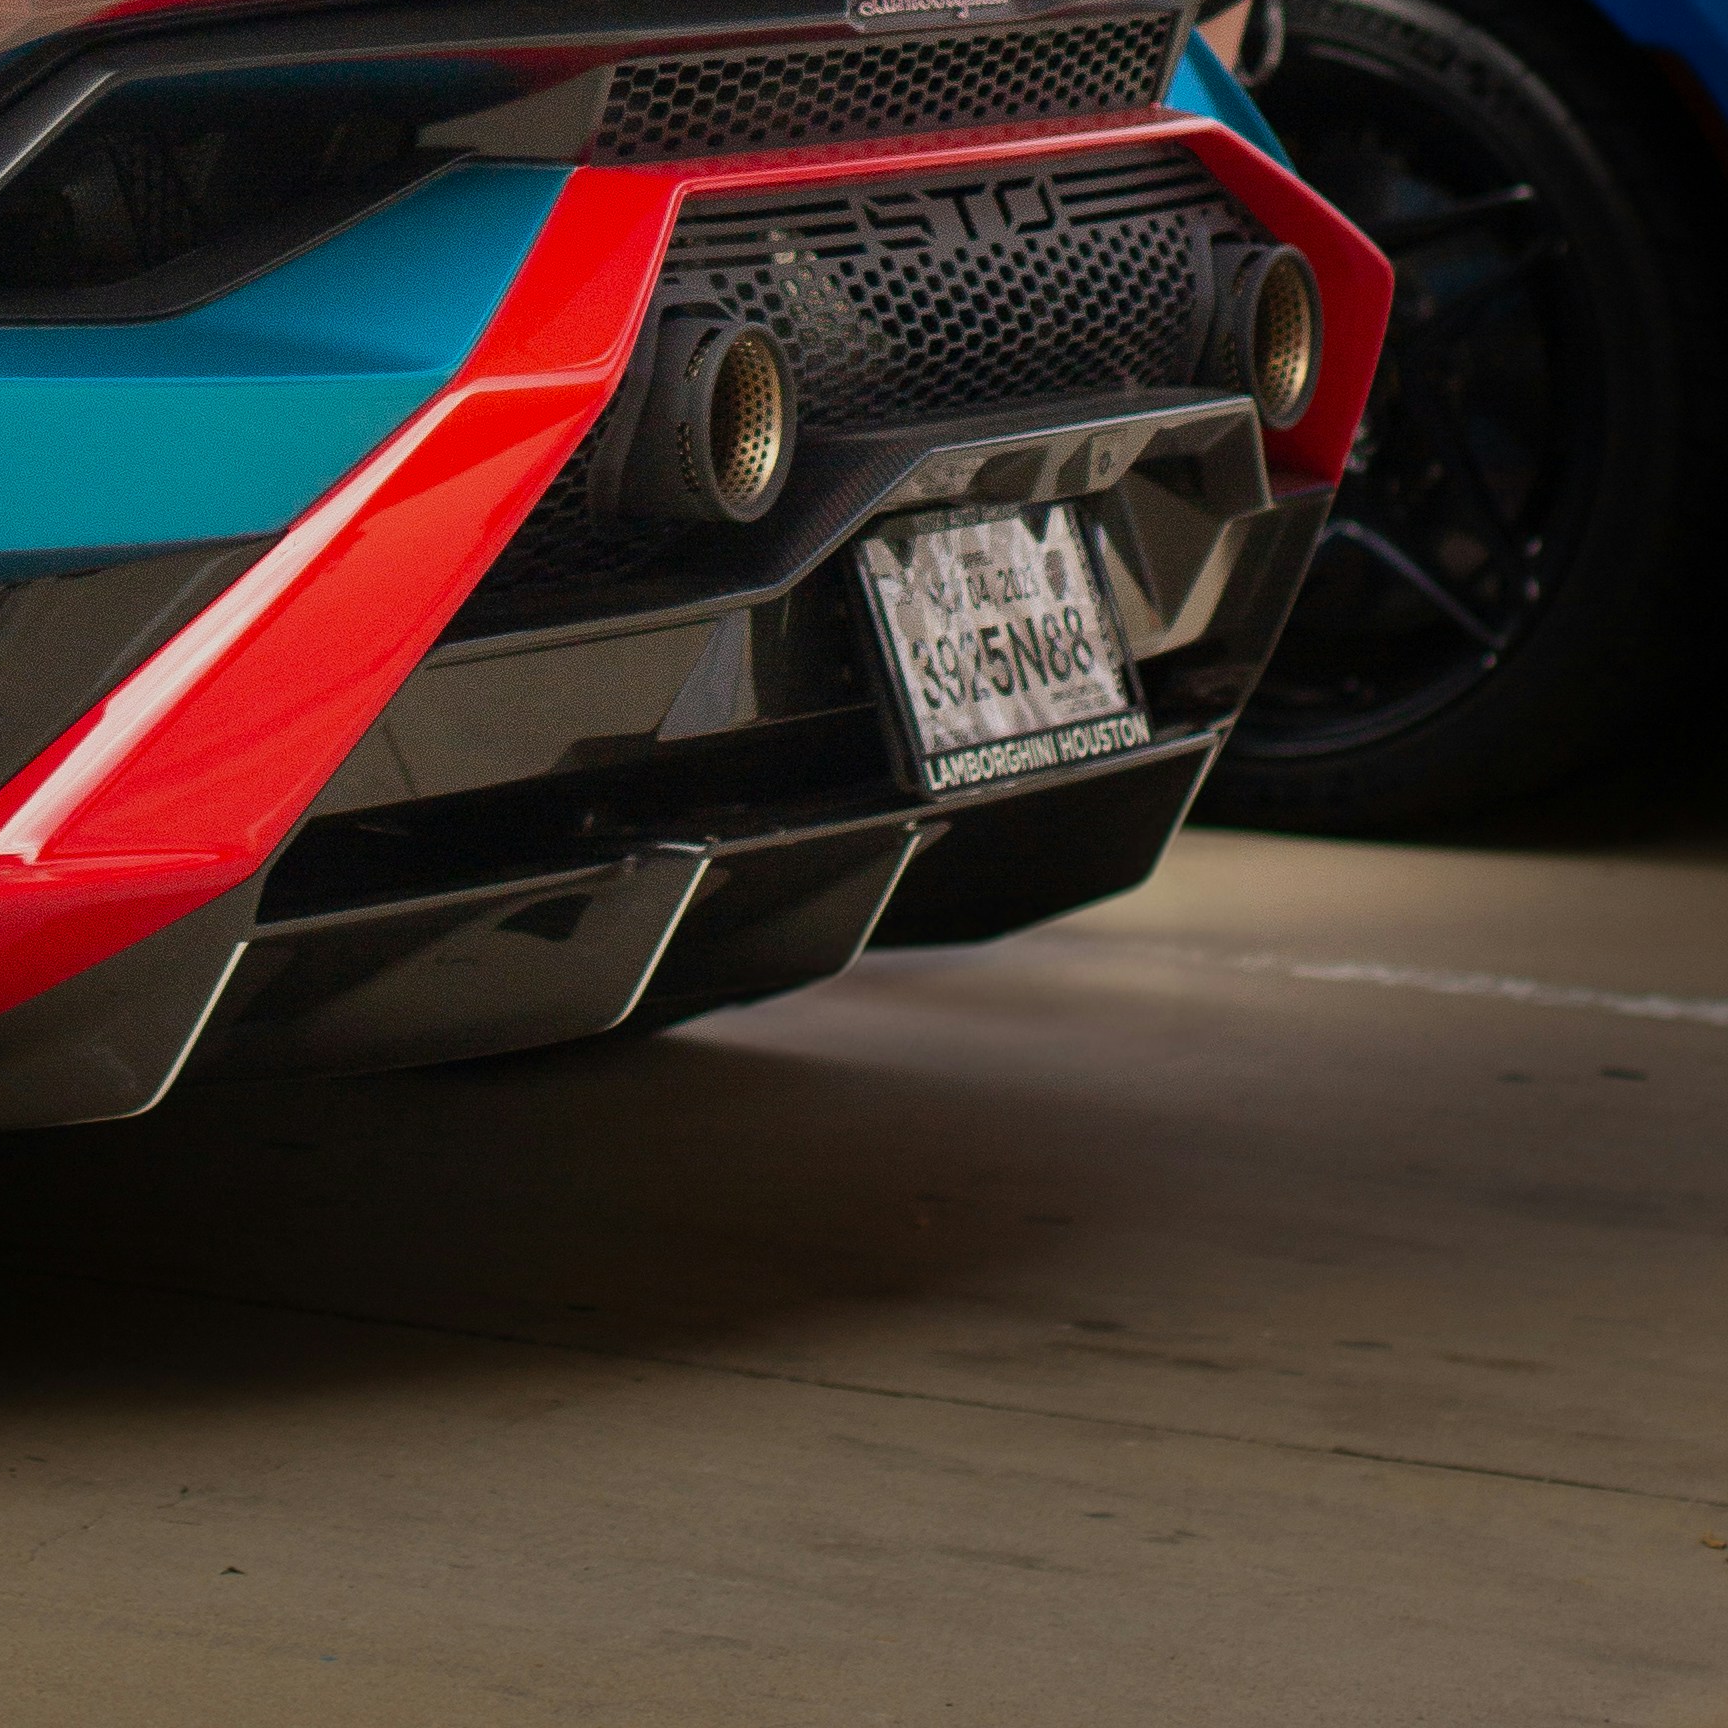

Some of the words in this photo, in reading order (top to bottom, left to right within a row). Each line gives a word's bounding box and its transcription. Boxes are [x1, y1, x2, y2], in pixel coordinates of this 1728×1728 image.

[862, 176, 1056, 250] STO
[925, 734, 1056, 791] LAMBORGHINI
[1057, 713, 1151, 765] HOUSTON
